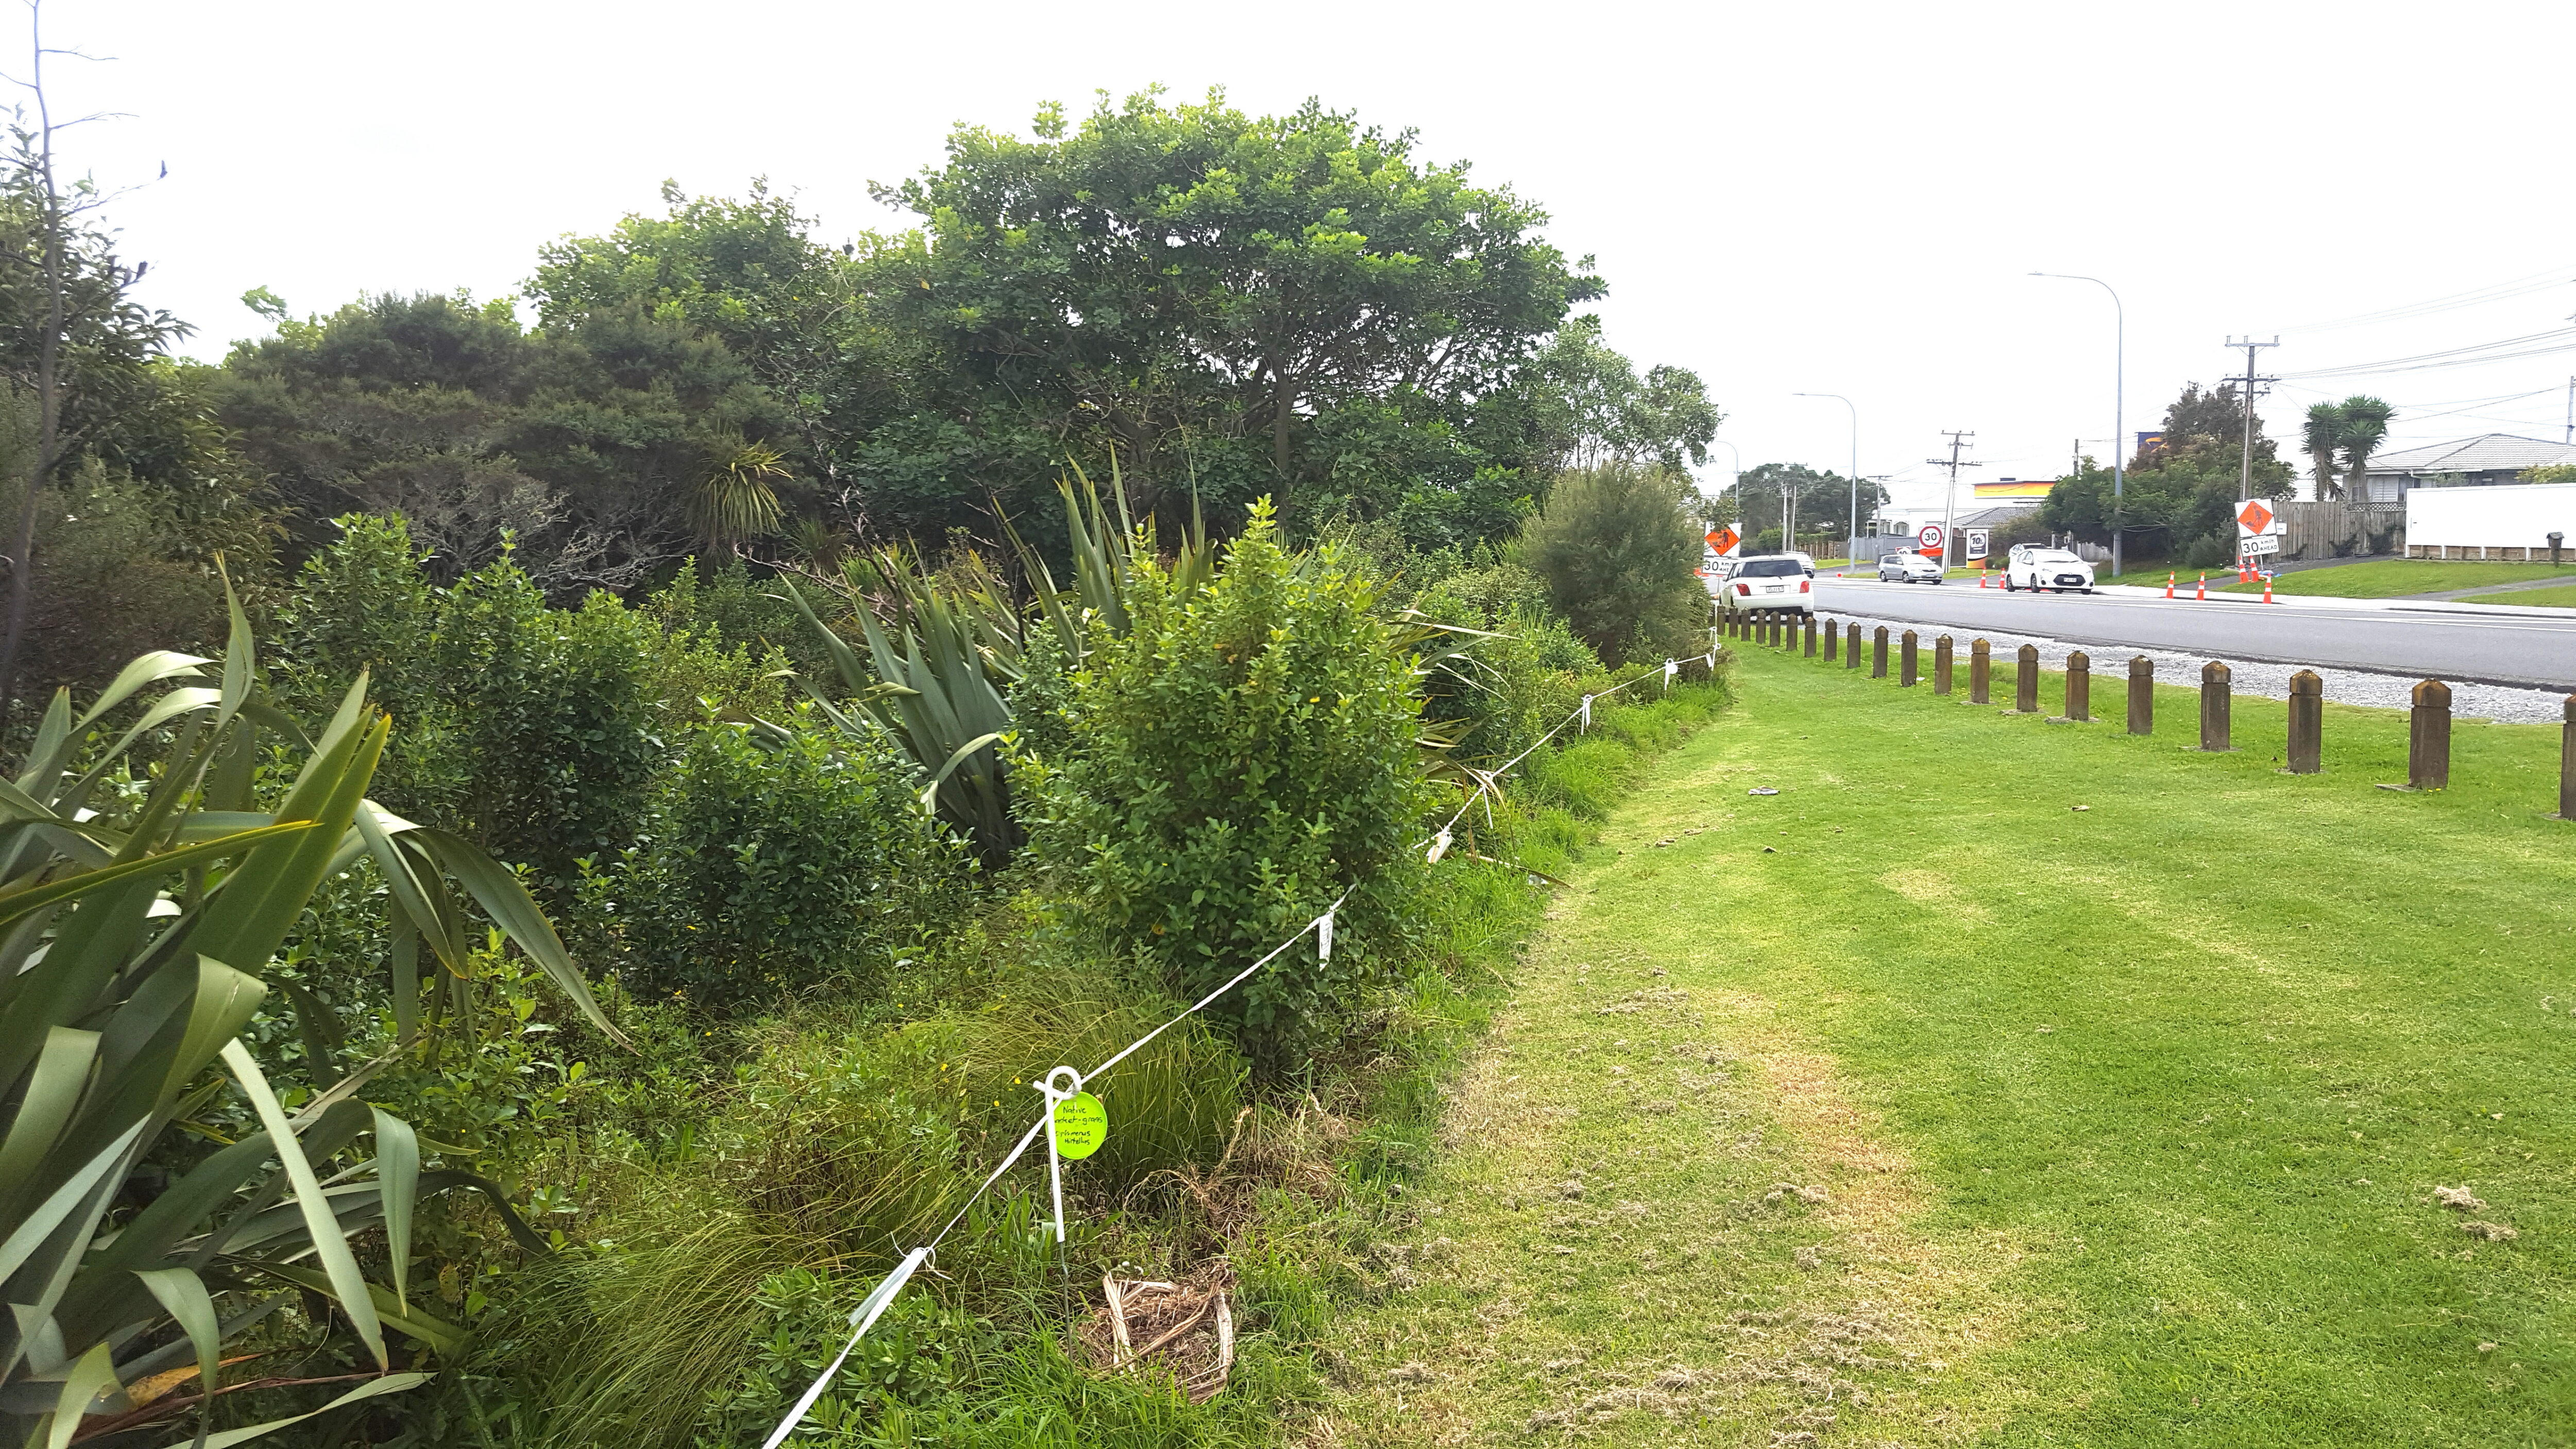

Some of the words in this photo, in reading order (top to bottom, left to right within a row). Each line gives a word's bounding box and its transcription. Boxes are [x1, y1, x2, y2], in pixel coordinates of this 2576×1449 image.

[1925, 533, 1937, 541] 30
[2243, 542, 2259, 553] 30
[1704, 559, 1719, 571] 30
[1063, 1105, 1087, 1114] Native
